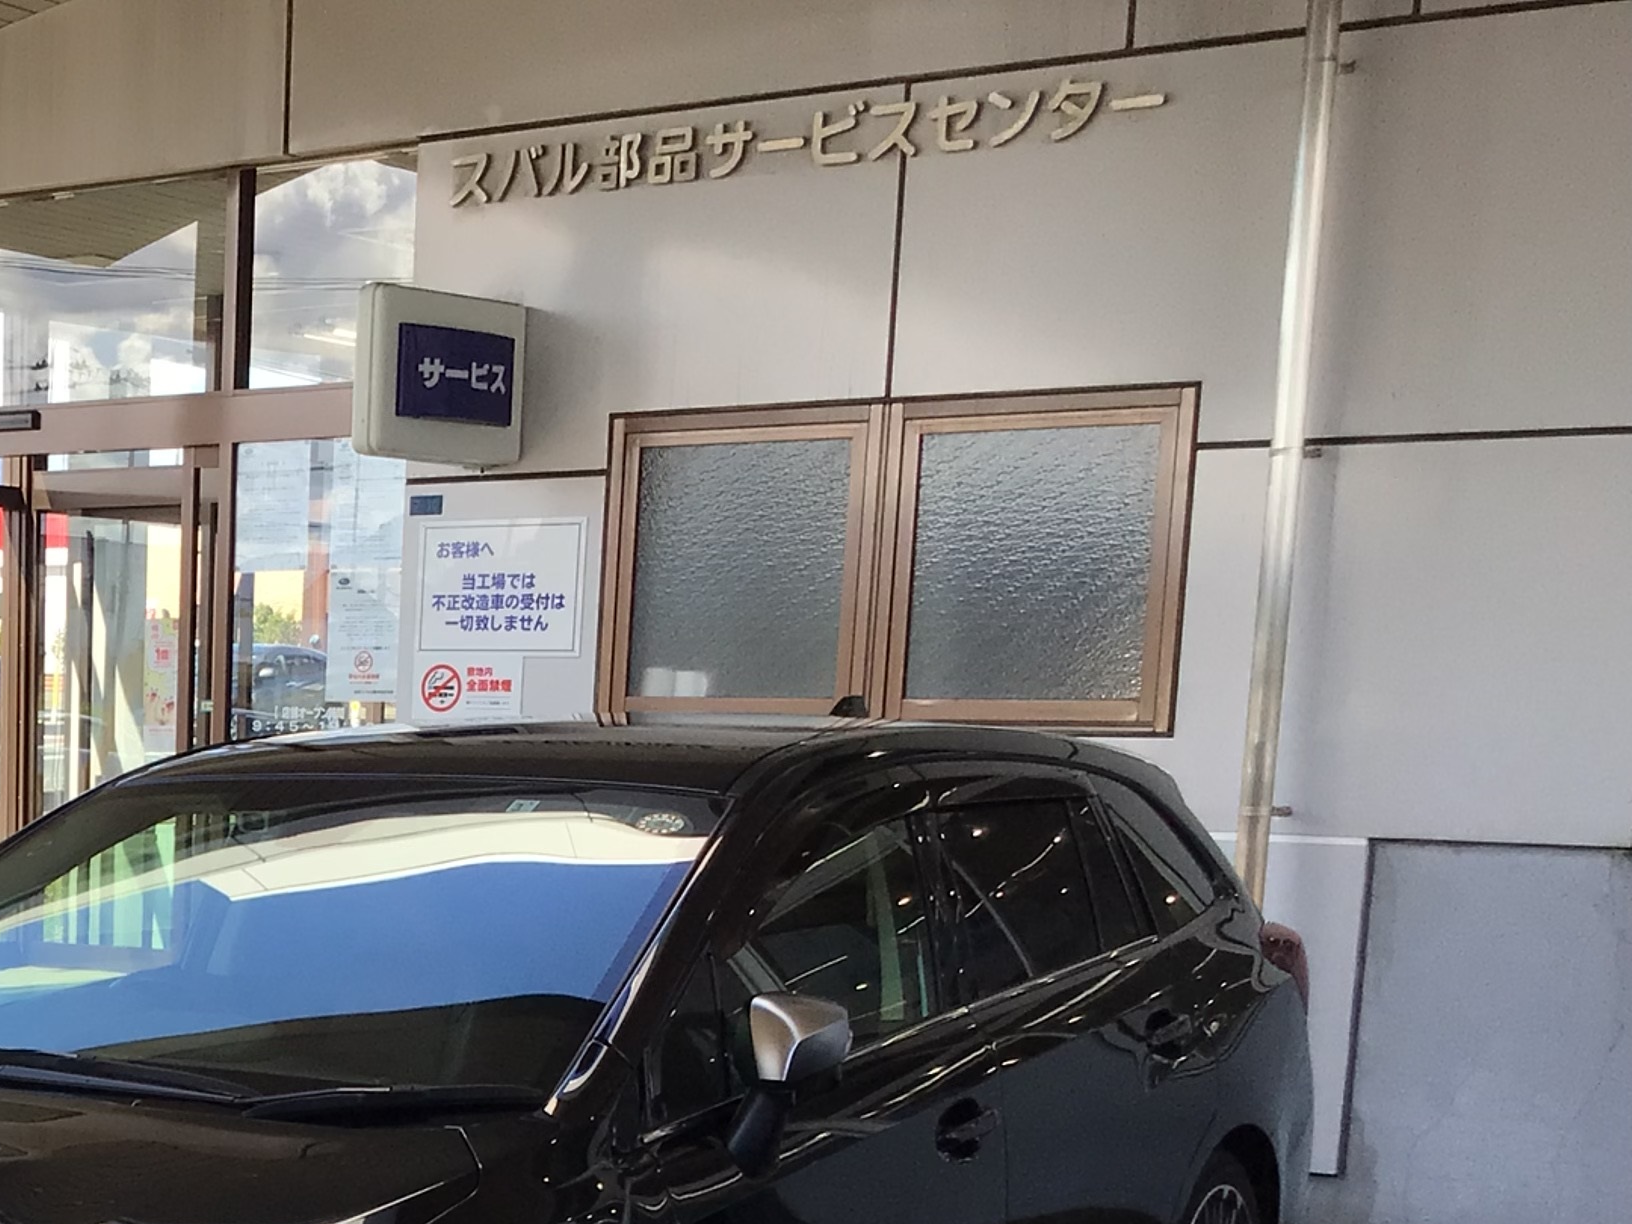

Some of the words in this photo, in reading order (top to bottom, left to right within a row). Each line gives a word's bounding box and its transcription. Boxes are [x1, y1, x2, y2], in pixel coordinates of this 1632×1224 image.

[449, 77, 1166, 208] スバル部品サービスセンター
[418, 357, 507, 395] サービス
[436, 541, 495, 559] お客様へ
[461, 572, 536, 590] 当工場では
[432, 593, 566, 611] 不正改造車の受付は
[445, 614, 549, 632] 一切致しません
[466, 679, 513, 692] 全面禁煙
